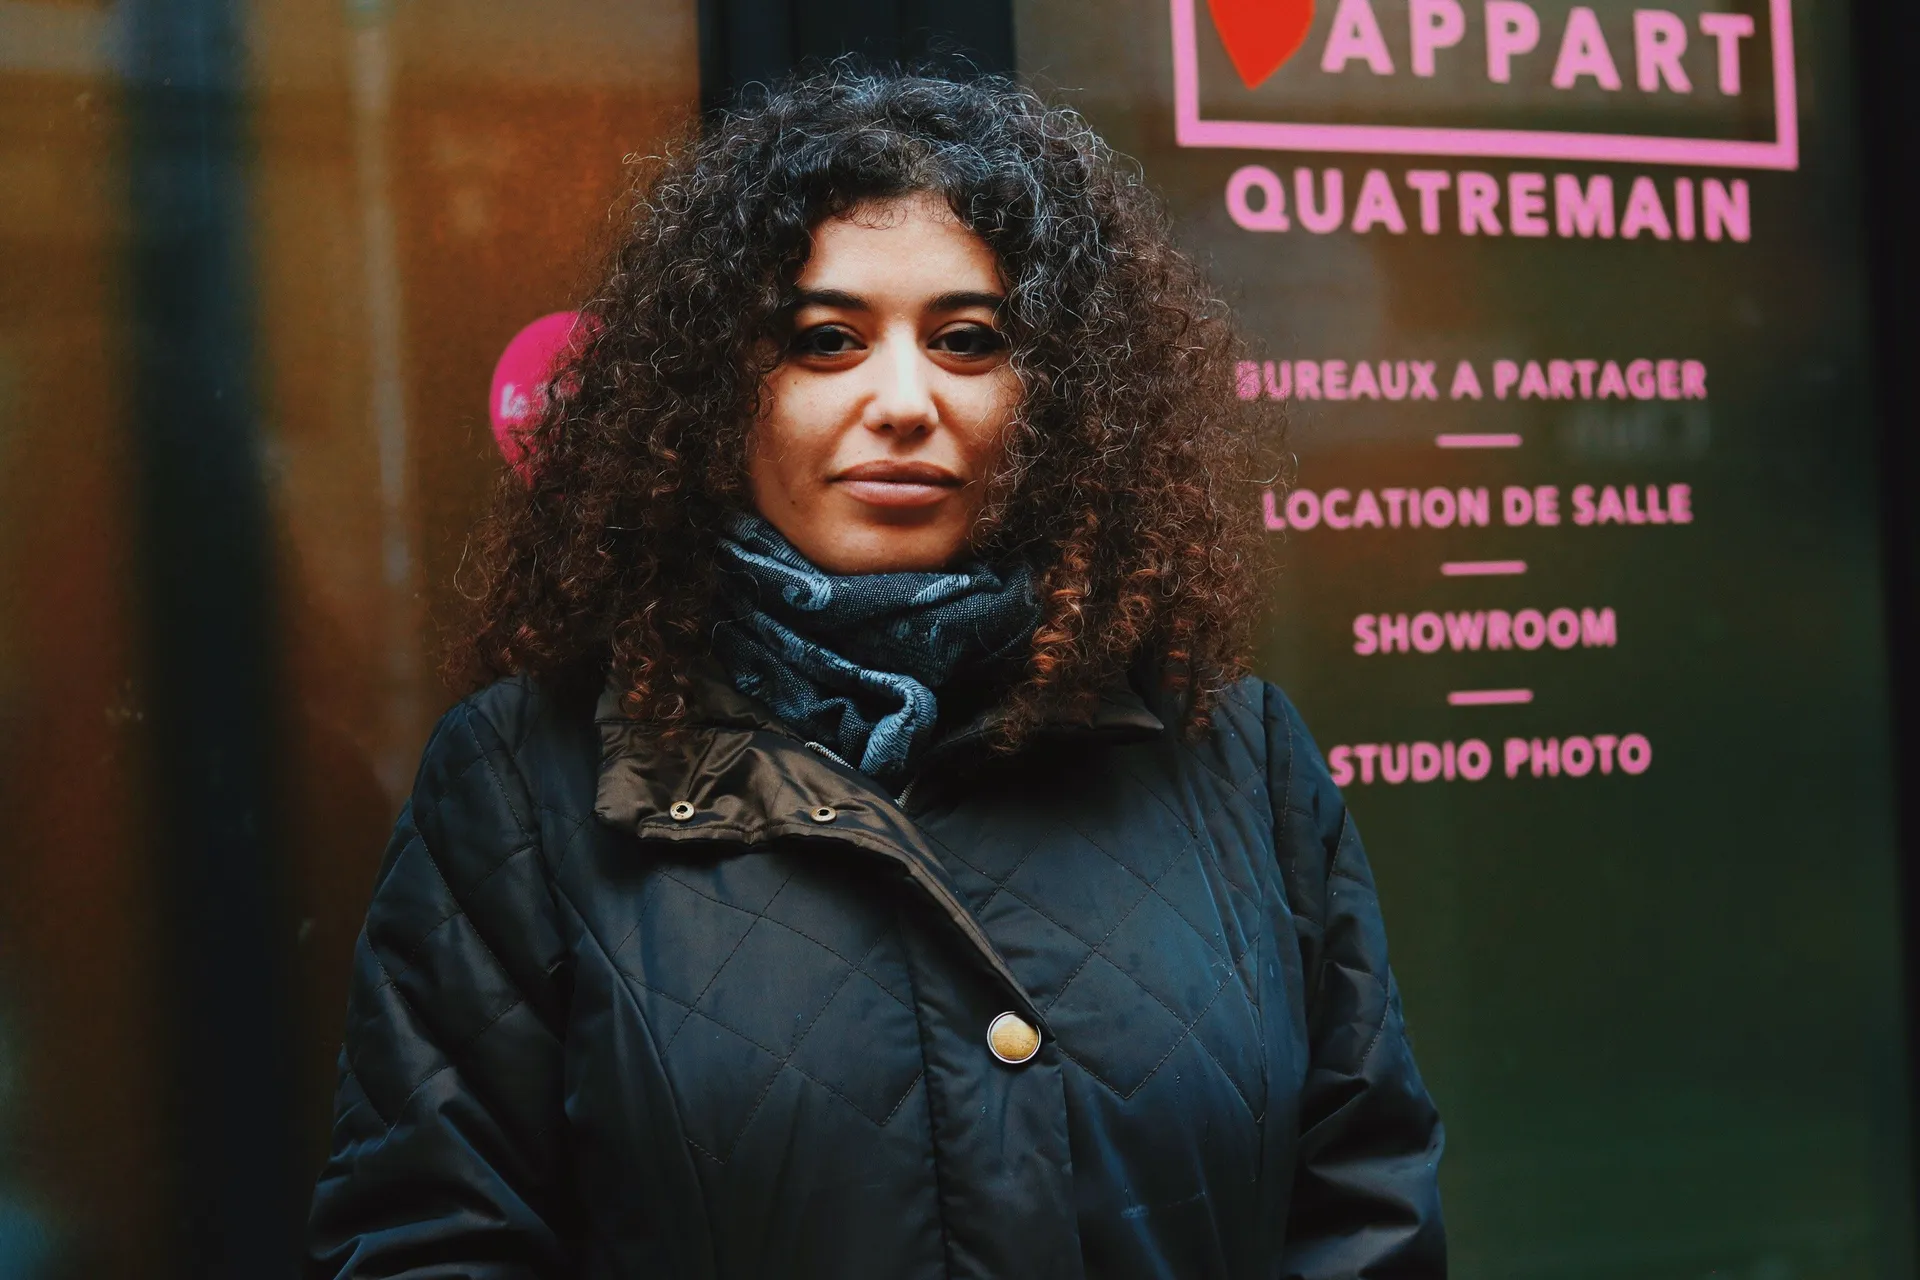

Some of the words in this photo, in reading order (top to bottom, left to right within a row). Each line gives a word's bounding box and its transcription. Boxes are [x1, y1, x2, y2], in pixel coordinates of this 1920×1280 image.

[1320, 0, 1755, 95] APPART
[1225, 165, 1750, 241] QUATREMAIN
[1234, 360, 1439, 400] BUREAUX
[1450, 361, 1483, 399] A
[1493, 359, 1708, 400] PARTAGER
[1261, 487, 1490, 531] LOCATION
[1502, 486, 1561, 526] DE
[1572, 484, 1694, 526] SALLE
[1352, 607, 1618, 656] SHOWROOM
[1328, 739, 1493, 787] STUDIO
[1503, 733, 1653, 779] PHOTO
